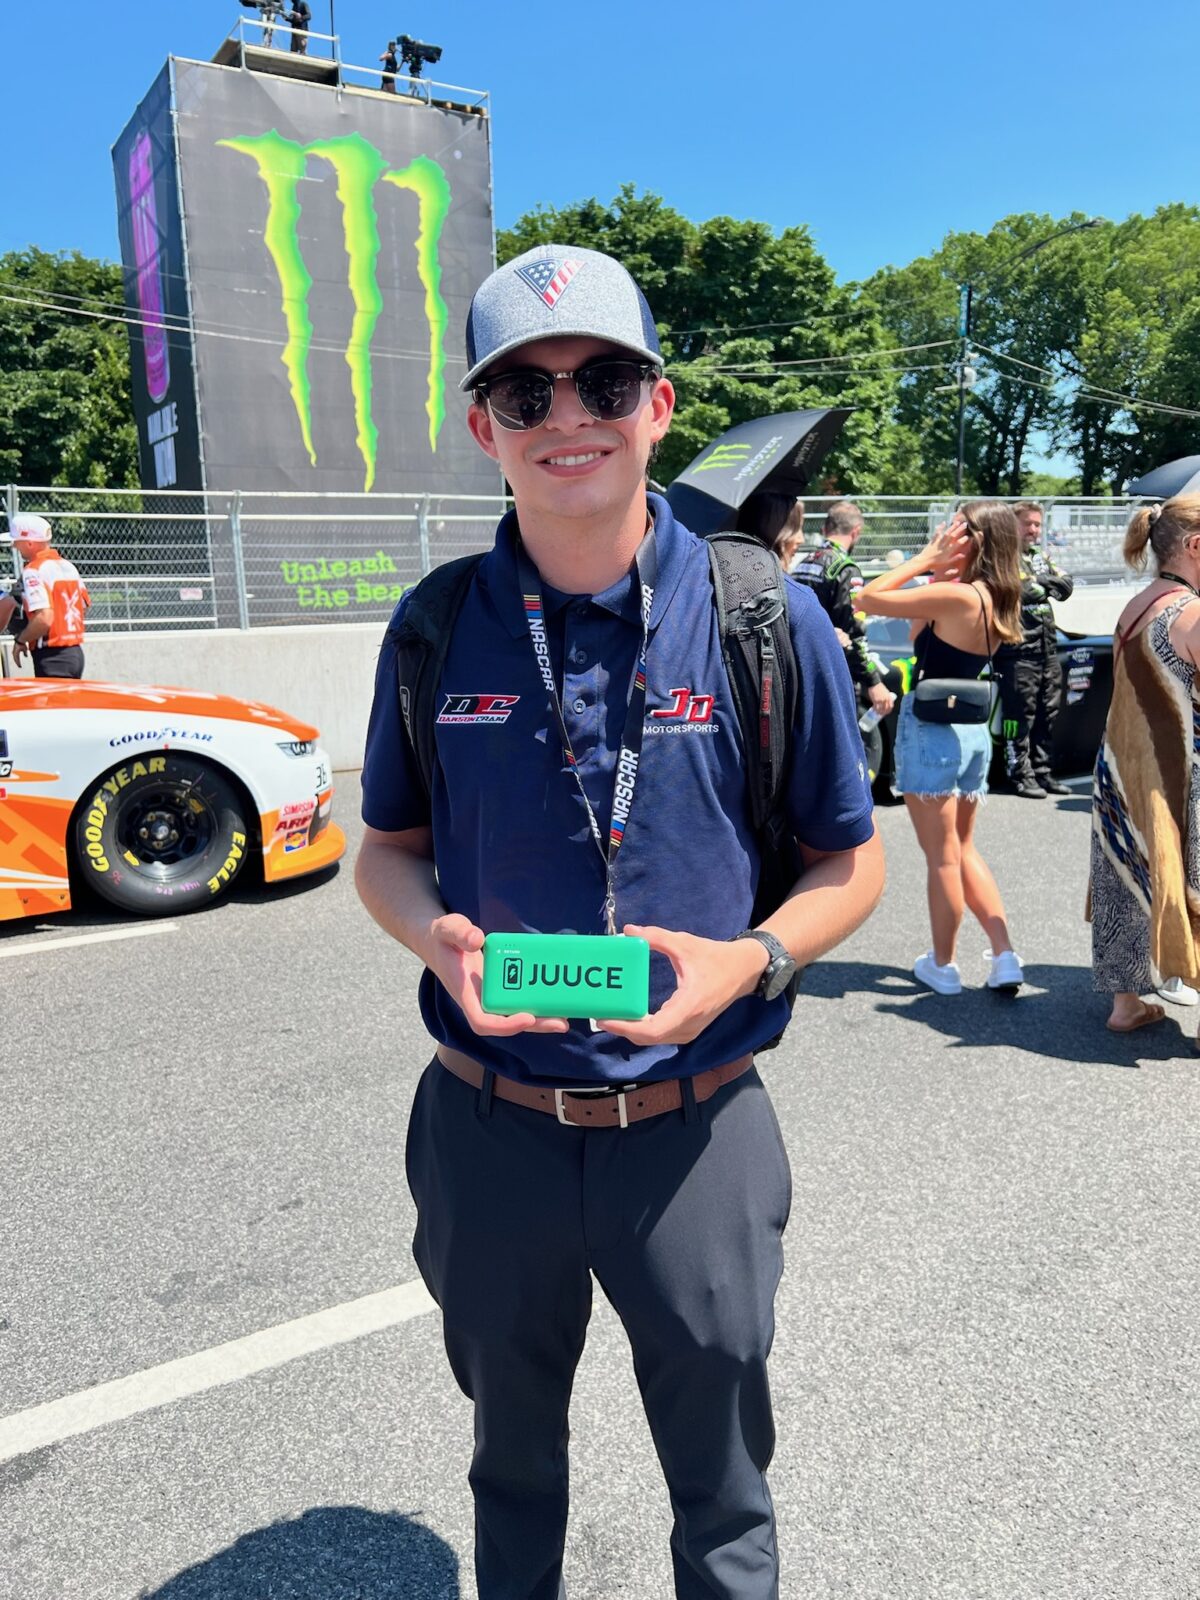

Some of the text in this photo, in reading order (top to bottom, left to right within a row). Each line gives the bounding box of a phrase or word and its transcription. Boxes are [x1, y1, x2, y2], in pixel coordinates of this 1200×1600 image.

[280, 549, 398, 584] Unleash
[297, 578, 419, 608] the Bea
[527, 618, 555, 692] NASCAR
[650, 687, 716, 723] JD
[109, 727, 214, 748] GOODYEAR
[642, 723, 720, 735] MOTORSPORTS
[612, 748, 640, 825] NASCAR
[275, 815, 313, 832] ARP
[206, 831, 246, 893] EAGLE
[528, 963, 623, 989] JUUCE
